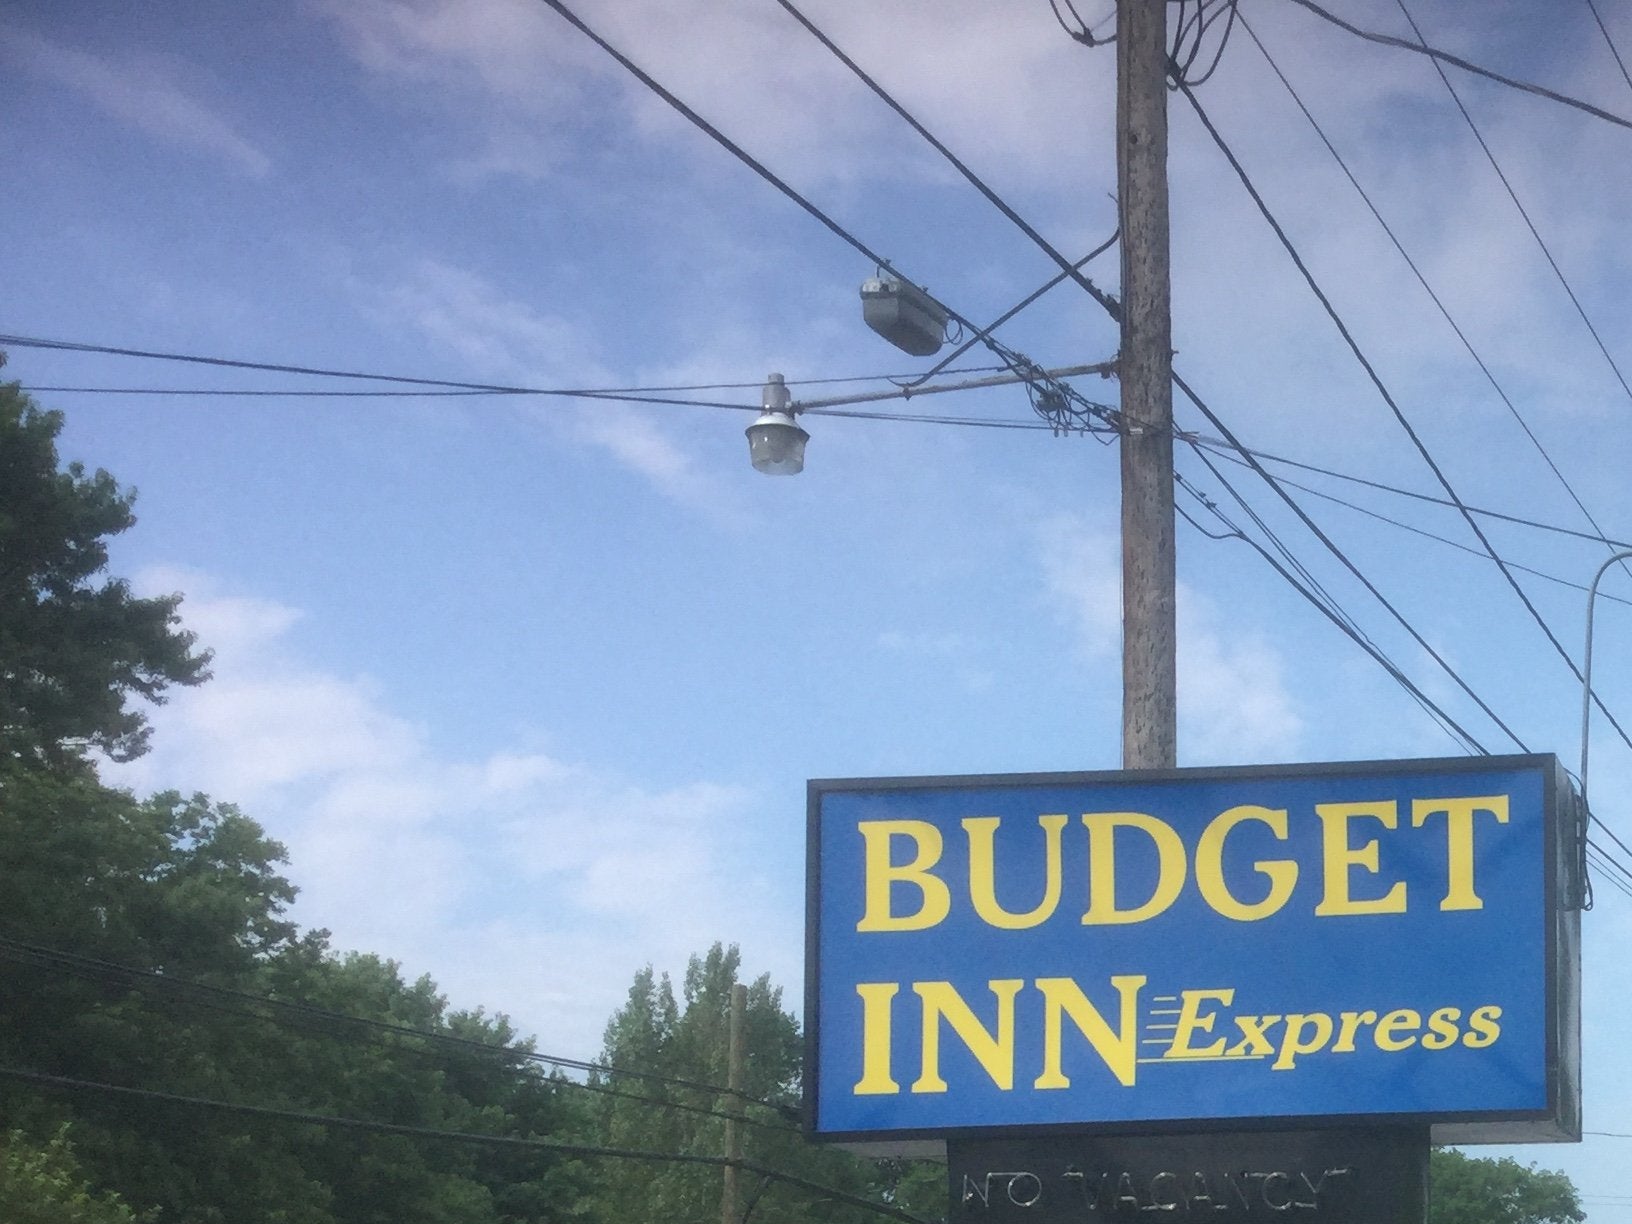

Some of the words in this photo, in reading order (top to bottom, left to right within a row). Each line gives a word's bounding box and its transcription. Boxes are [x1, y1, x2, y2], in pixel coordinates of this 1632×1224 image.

[856, 795, 1509, 933] BUDGET
[853, 974, 1147, 1096] INN
[1163, 988, 1502, 1071] Express
[962, 1171, 1043, 1209] NO
